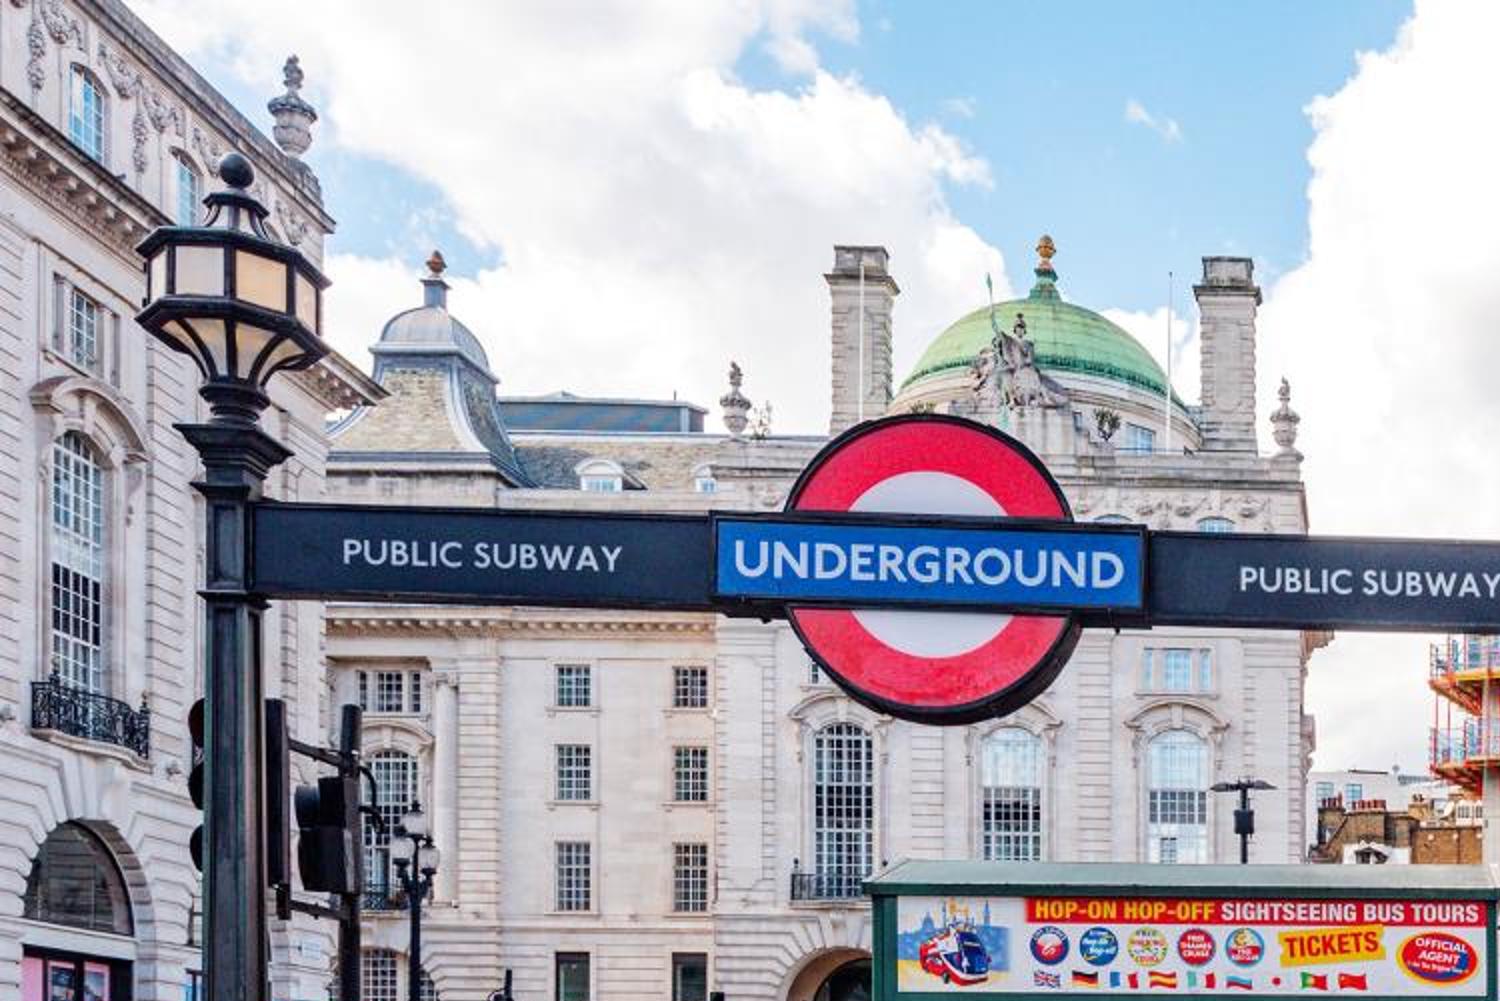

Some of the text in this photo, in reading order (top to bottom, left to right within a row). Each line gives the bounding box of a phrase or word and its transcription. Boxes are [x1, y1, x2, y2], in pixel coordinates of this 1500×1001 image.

[342, 538, 623, 574] PUBLIC SUBWAY
[735, 540, 1125, 590] UNDERGROUND
[1239, 565, 1357, 596] PUBLIC
[1035, 901, 1479, 923] HOP-ON HOP-OFF SIGHTSEEING BUS TOURS
[1284, 931, 1379, 959] TICKETS
[1415, 937, 1467, 952] OFFICIAL
[1417, 949, 1461, 965] AGENT
